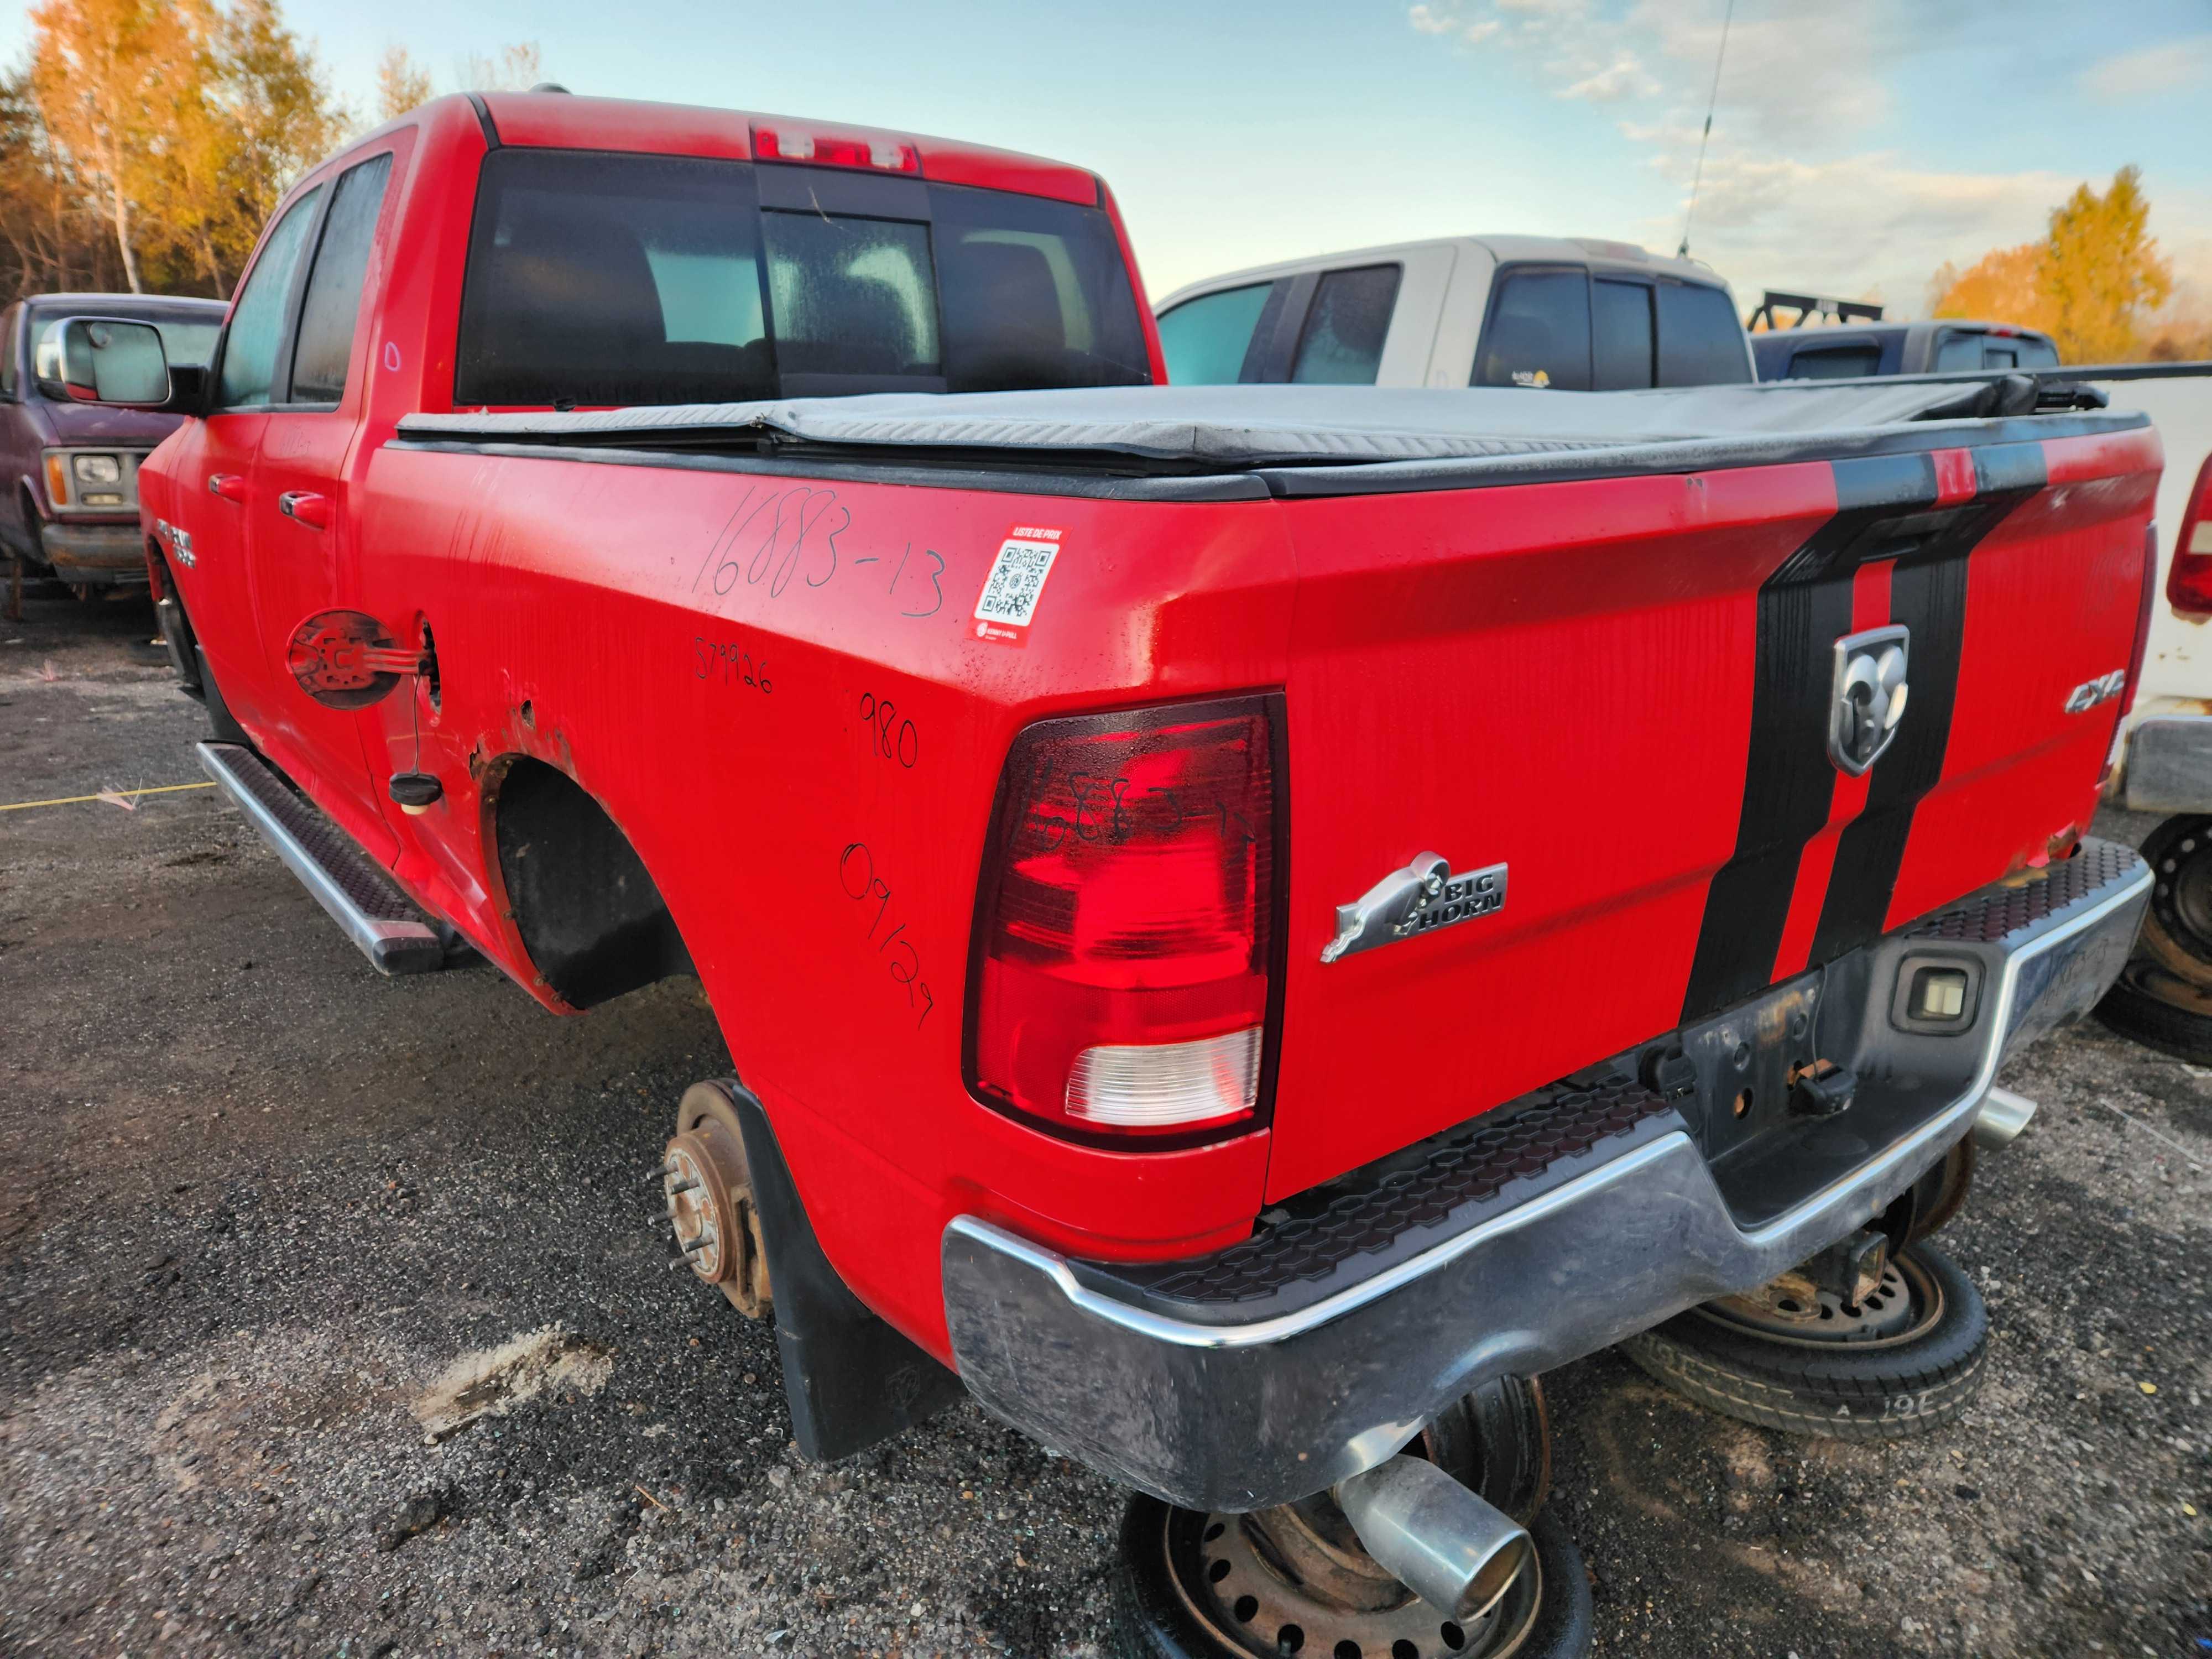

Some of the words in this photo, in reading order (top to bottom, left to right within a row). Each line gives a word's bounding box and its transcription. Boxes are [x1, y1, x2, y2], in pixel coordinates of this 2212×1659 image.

[692, 486, 945, 617] 16883-13
[1013, 526, 1034, 538] LISTE
[1032, 528, 1044, 539] DE
[1043, 529, 1062, 540] PRIX
[695, 637, 772, 694] 579926
[859, 692, 918, 768] 980
[1417, 891, 1503, 931] HORN
[1444, 874, 1494, 905] BIG
